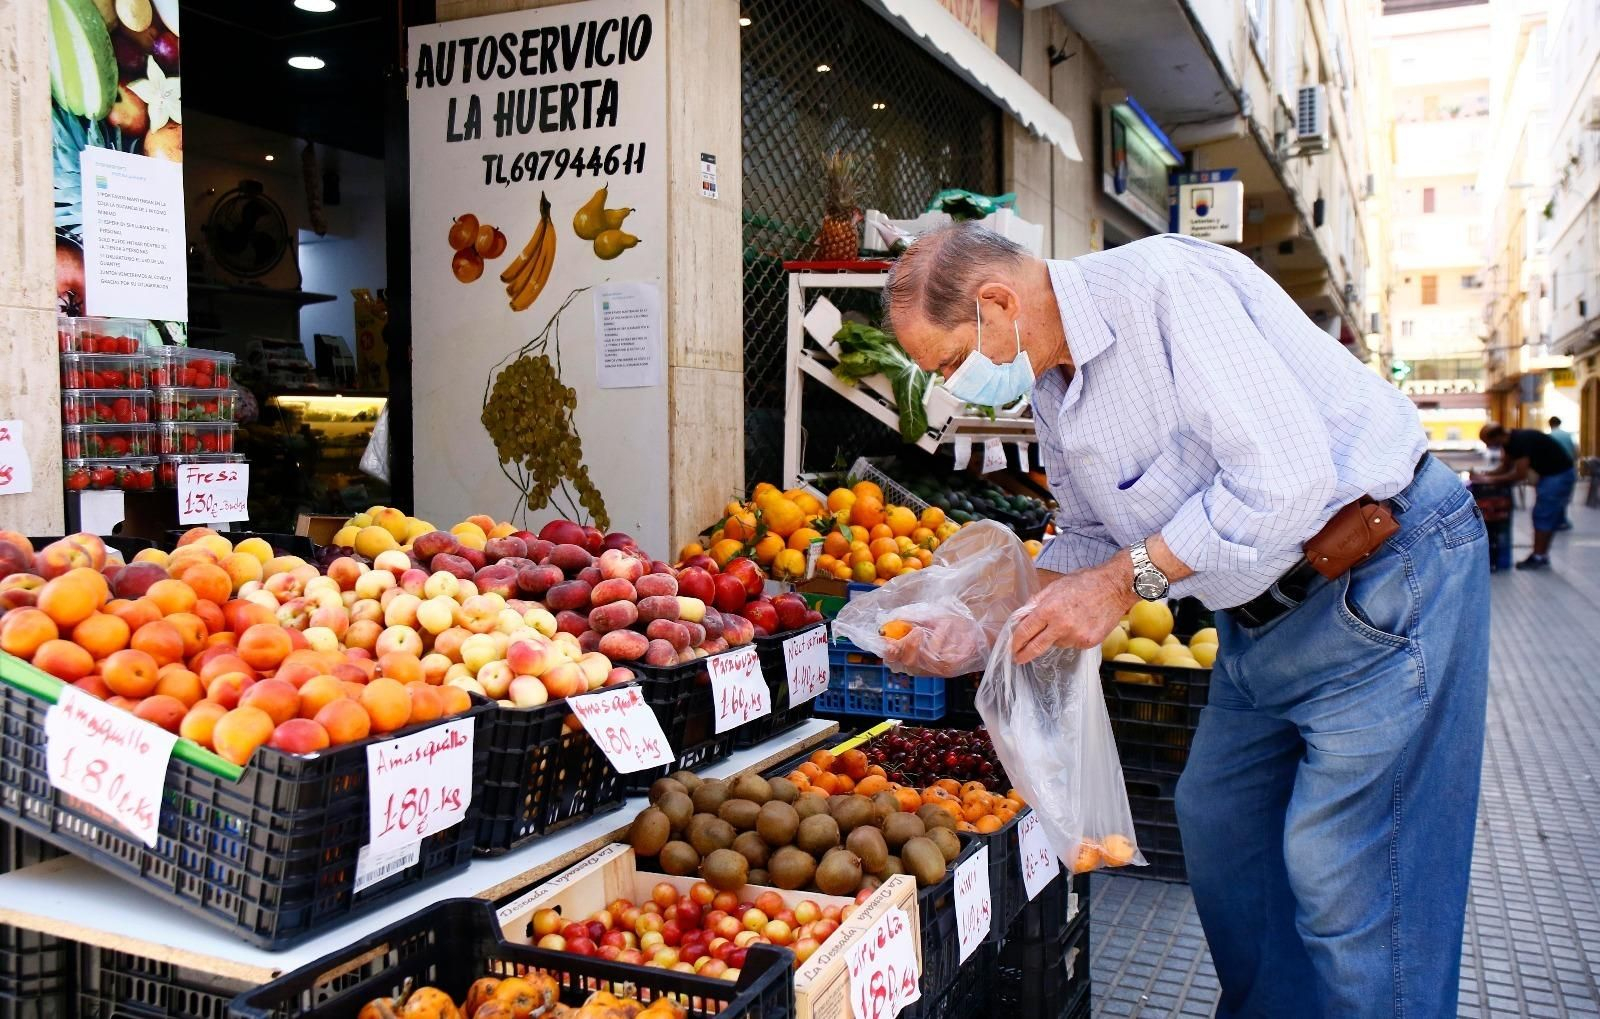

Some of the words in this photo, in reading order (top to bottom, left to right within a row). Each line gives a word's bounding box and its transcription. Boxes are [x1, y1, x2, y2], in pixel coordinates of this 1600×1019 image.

[415, 13, 652, 89] AUTOSERVICIO
[446, 94, 482, 143] LA
[493, 78, 619, 138] HUERTA
[187, 467, 238, 485] Fresa
